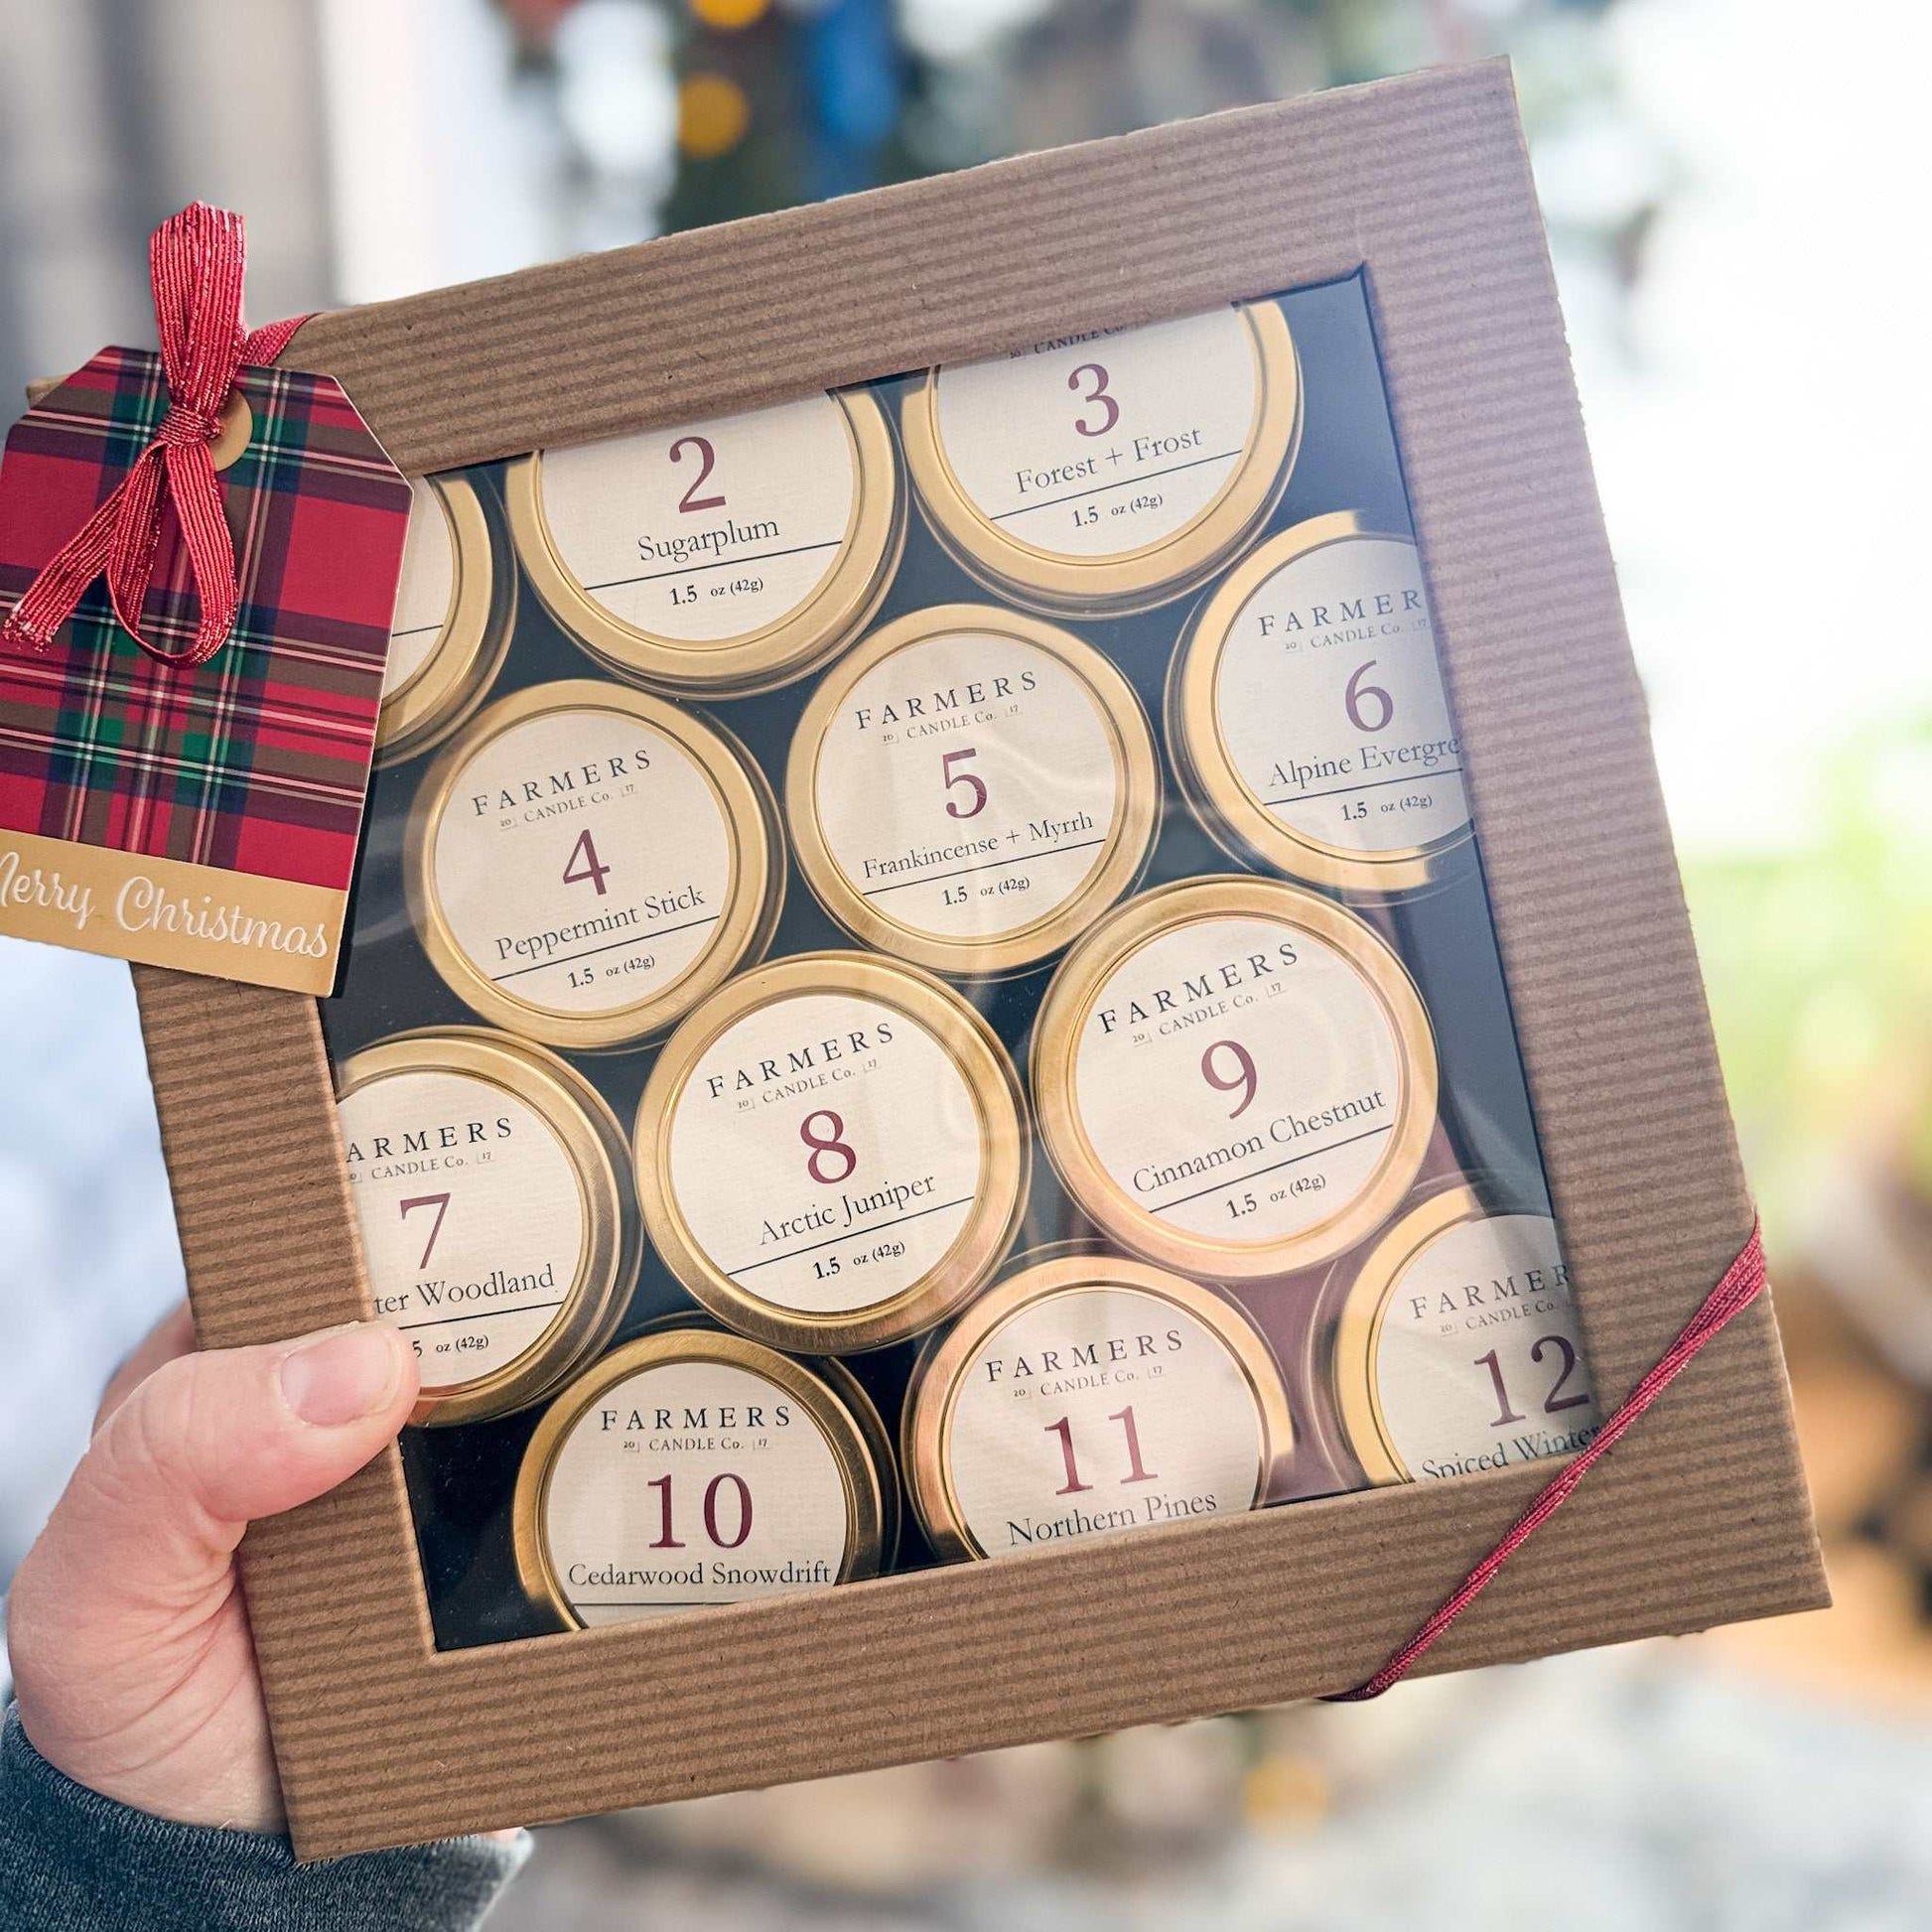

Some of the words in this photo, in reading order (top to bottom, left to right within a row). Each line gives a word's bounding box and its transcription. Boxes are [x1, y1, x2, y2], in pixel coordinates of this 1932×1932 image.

[1067, 363, 1120, 437] 3
[668, 436, 727, 514] 2
[1014, 455, 1097, 494] Forest
[1132, 426, 1202, 463] Frost
[1072, 505, 1099, 528] 1.5
[1110, 503, 1127, 516] oz
[1130, 493, 1165, 514] (42g)
[637, 517, 780, 563] Sugarplum
[669, 585, 698, 607] 1.5
[710, 584, 727, 598] oz
[730, 577, 764, 597] (42g)
[1310, 624, 1377, 649] CANDLE
[855, 670, 1036, 731] FARMERS
[1345, 659, 1393, 733] 6
[906, 715, 971, 740] CANDLE
[471, 750, 651, 817] FARMERS
[943, 748, 988, 818] 5
[1268, 755, 1351, 790] Alpine
[523, 795, 588, 824] CANDLE
[1341, 800, 1368, 822] 1.5
[1380, 803, 1396, 813] oz
[1399, 794, 1433, 812] (42g)
[563, 828, 611, 896] 4
[863, 836, 1001, 880] Frankincense
[1028, 811, 1094, 843] Myrrh
[115, 875, 329, 959] Christmas
[943, 886, 969, 906] 1.5
[979, 886, 995, 897] oz
[998, 876, 1031, 896] (42g)
[494, 906, 641, 961] Peppermint
[644, 885, 706, 919] Stick
[567, 967, 595, 989] 1.5
[605, 965, 621, 978] oz
[623, 954, 656, 975] (42g)
[1097, 942, 1299, 1035] FARMERS
[1159, 1000, 1230, 1036] CANDLE
[706, 1022, 894, 1099] FARMERS
[1201, 1039, 1257, 1120] 9
[761, 1073, 828, 1104] CANDLE
[800, 1110, 857, 1184] 8
[1133, 1136, 1266, 1193] Cinnamon
[1269, 1089, 1387, 1144] Chestnut
[370, 1158, 440, 1180] CANDLE
[1225, 1192, 1258, 1219] 1.5
[1269, 1188, 1288, 1203] oz
[1290, 1173, 1326, 1198] (42g)
[400, 1192, 451, 1270] 7
[759, 1203, 836, 1246] Arctic
[842, 1174, 936, 1228] Juniper
[416, 1263, 555, 1308] Woodland
[812, 1256, 841, 1280] 1.5
[852, 1254, 869, 1266] oz
[872, 1241, 906, 1262] (42g)
[436, 1342, 452, 1353] oz
[455, 1333, 489, 1353] (42g)
[1465, 1303, 1532, 1330] CANDLE
[985, 1329, 1183, 1383] FARMERS
[1473, 1334, 1590, 1428] 12
[1040, 1372, 1110, 1397] CANDLE
[601, 1405, 790, 1431] FARMERS
[648, 1438, 716, 1451] CANDLE
[1043, 1405, 1159, 1495] 11
[647, 1472, 754, 1549] 10
[1007, 1508, 1137, 1547] Northern
[1143, 1492, 1218, 1522] Pines
[568, 1561, 705, 1587] Cedarwood
[711, 1559, 832, 1586] Snowdrift
